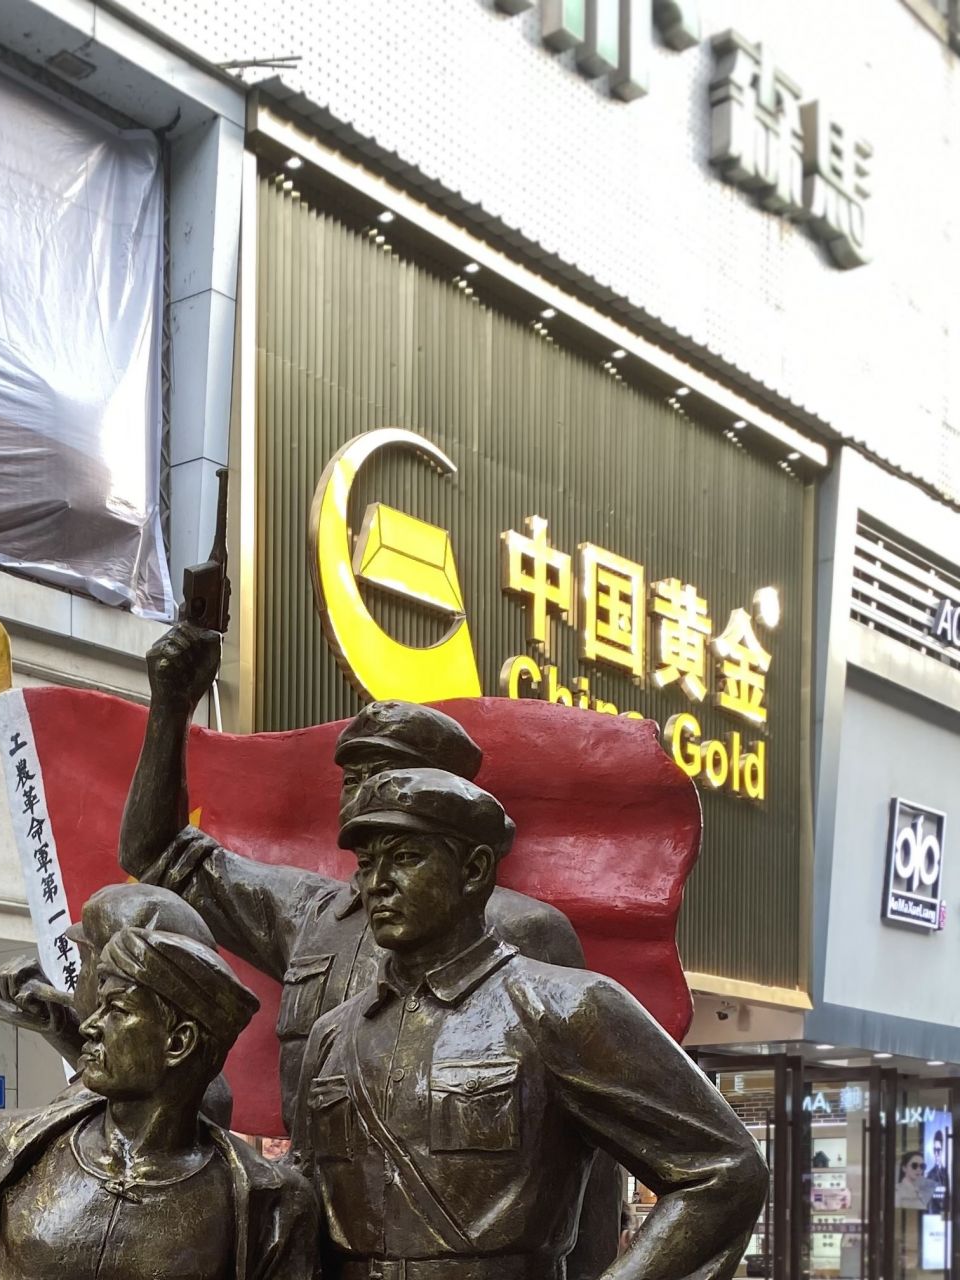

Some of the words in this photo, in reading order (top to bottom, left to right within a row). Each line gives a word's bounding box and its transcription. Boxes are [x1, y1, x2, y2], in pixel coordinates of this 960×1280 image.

[501, 515, 770, 723] 中国黄金
[664, 712, 765, 800] Gold
